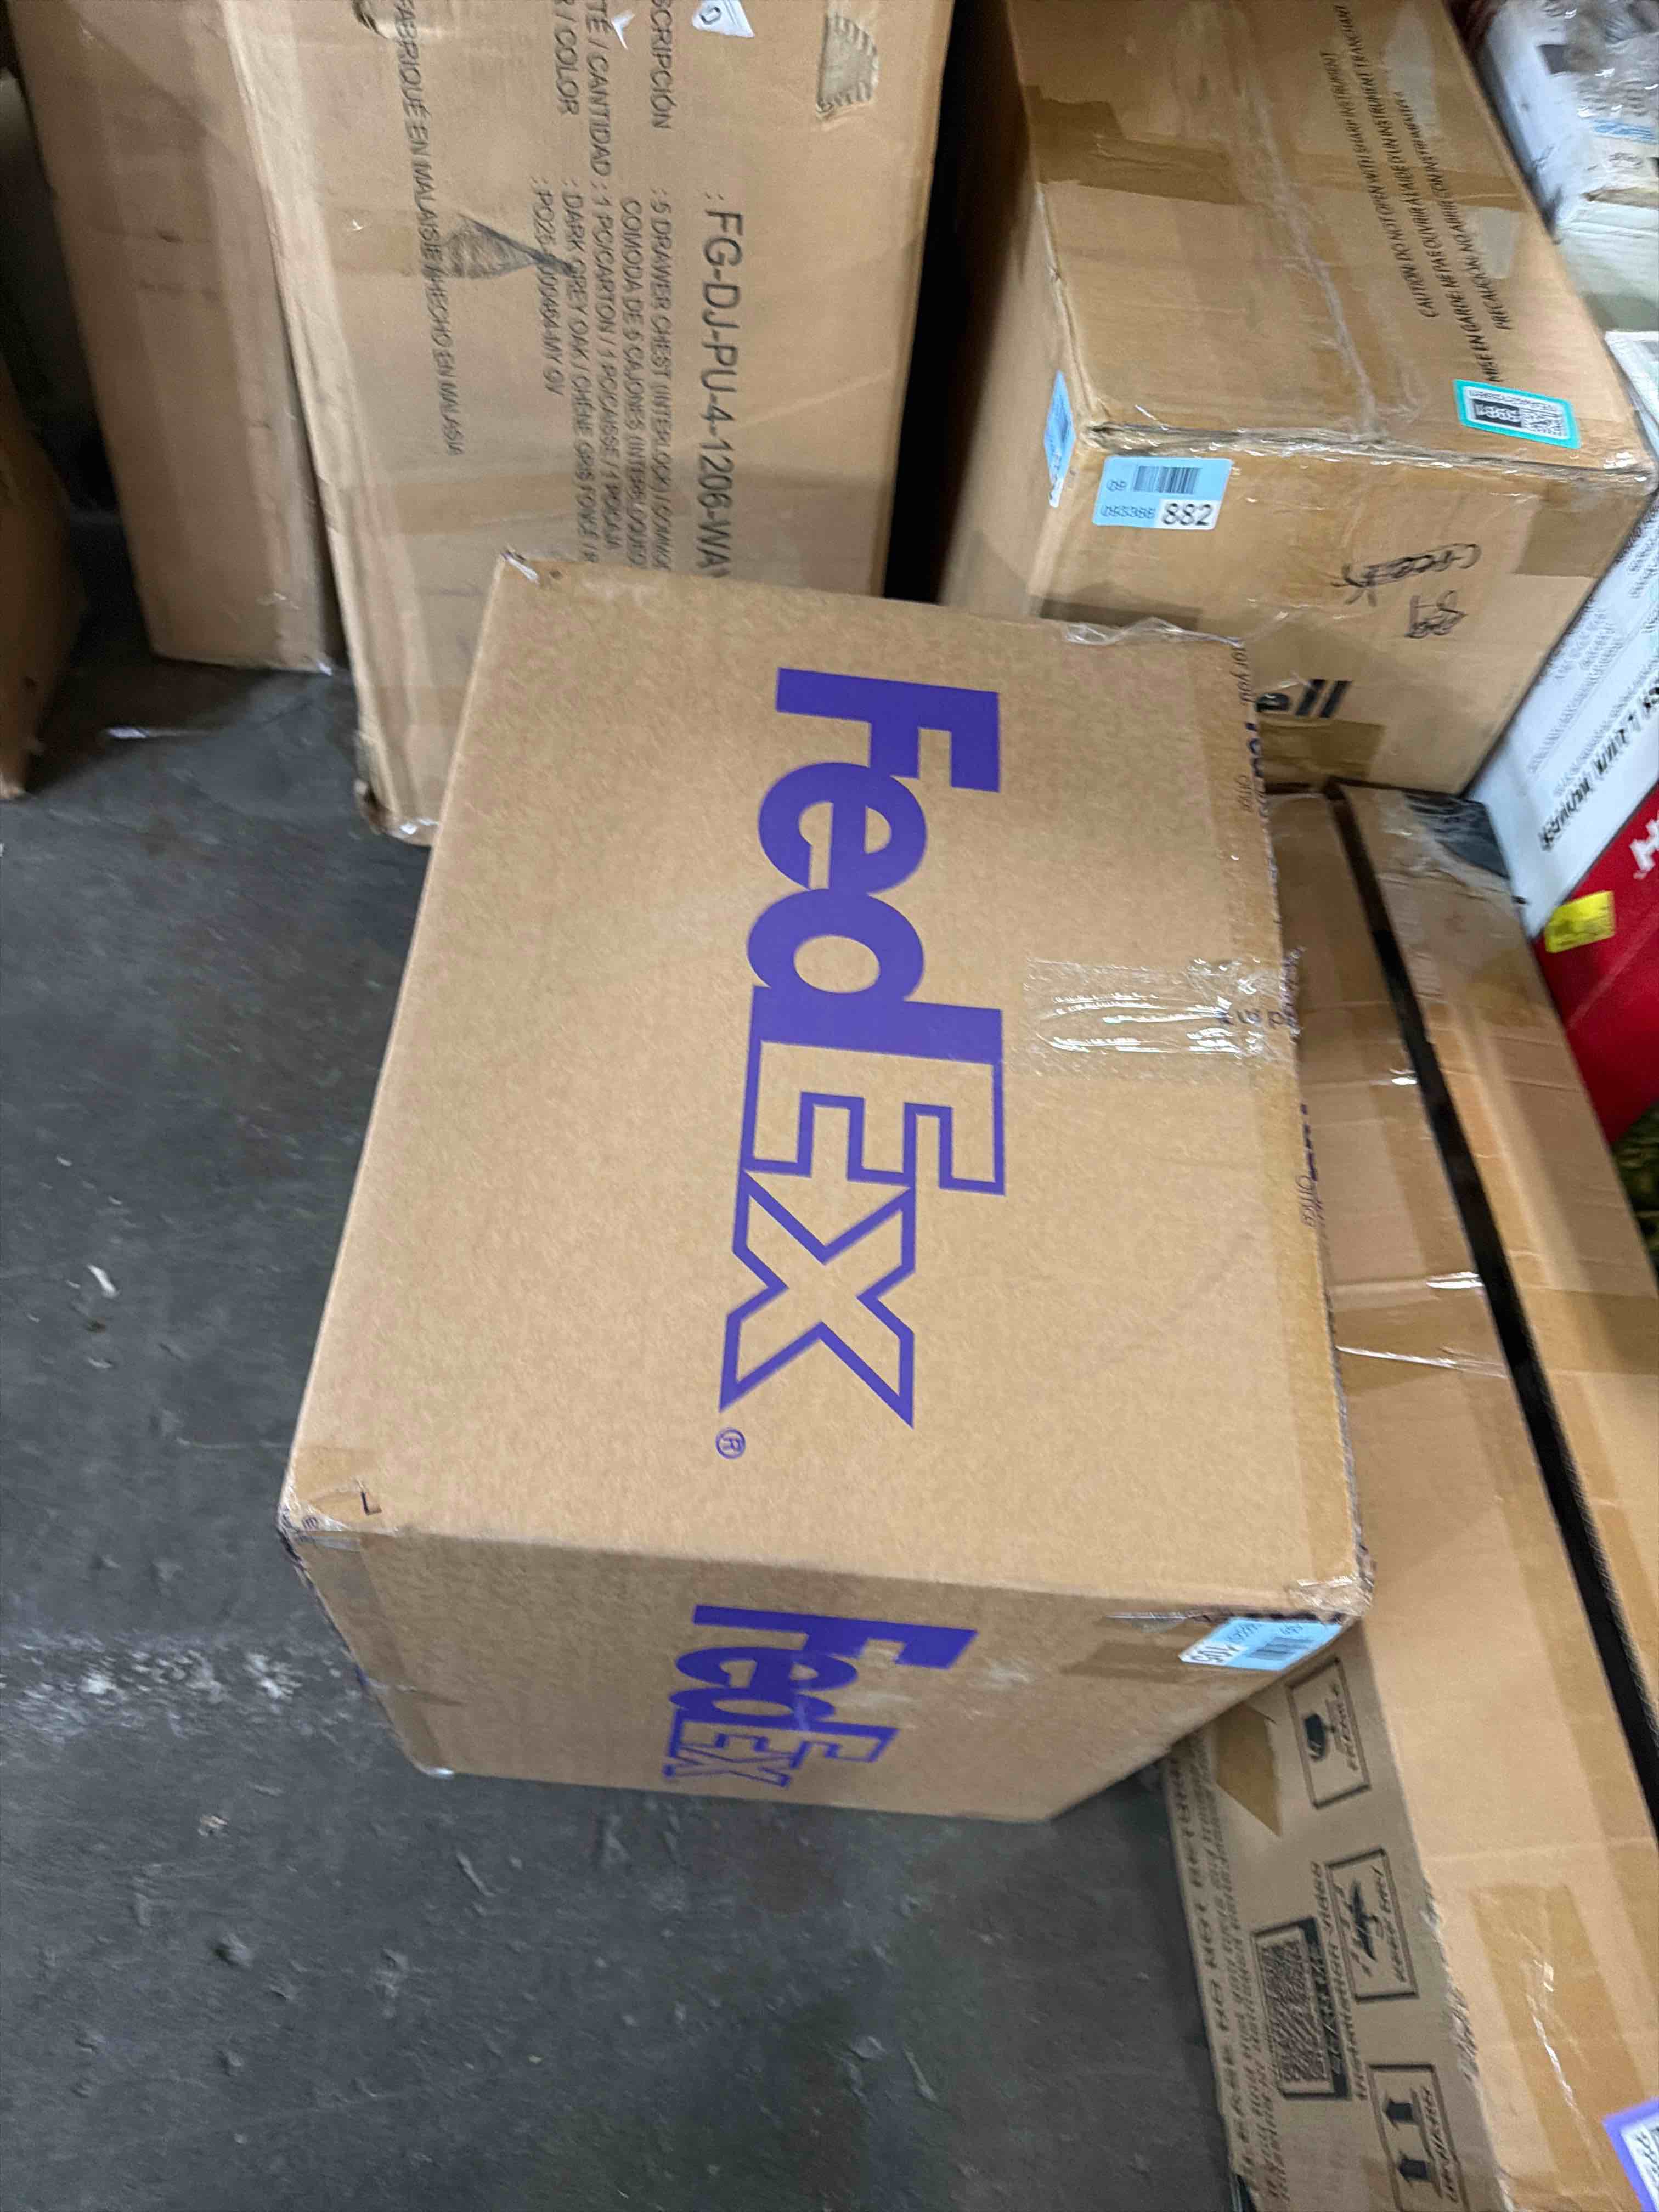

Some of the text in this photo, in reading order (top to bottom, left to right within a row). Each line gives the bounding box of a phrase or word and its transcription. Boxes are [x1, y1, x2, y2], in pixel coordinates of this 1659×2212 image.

[554, 27, 580, 116] COLOR
[587, 53, 613, 177] CANTIDAD
[405, 121, 432, 163] EN
[561, 191, 585, 253] DARK
[620, 197, 644, 294] COMODA
[651, 218, 673, 311] DRAWER
[593, 215, 616, 332] PC/CARTON
[623, 295, 645, 325] DE
[568, 318, 591, 362] OAK
[650, 315, 673, 381] CHEST
[623, 345, 646, 432] CAJONES
[1161, 502, 1213, 526] 882
[719, 667, 1005, 1429] FedEx
[662, 1604, 980, 1790] FedEx
